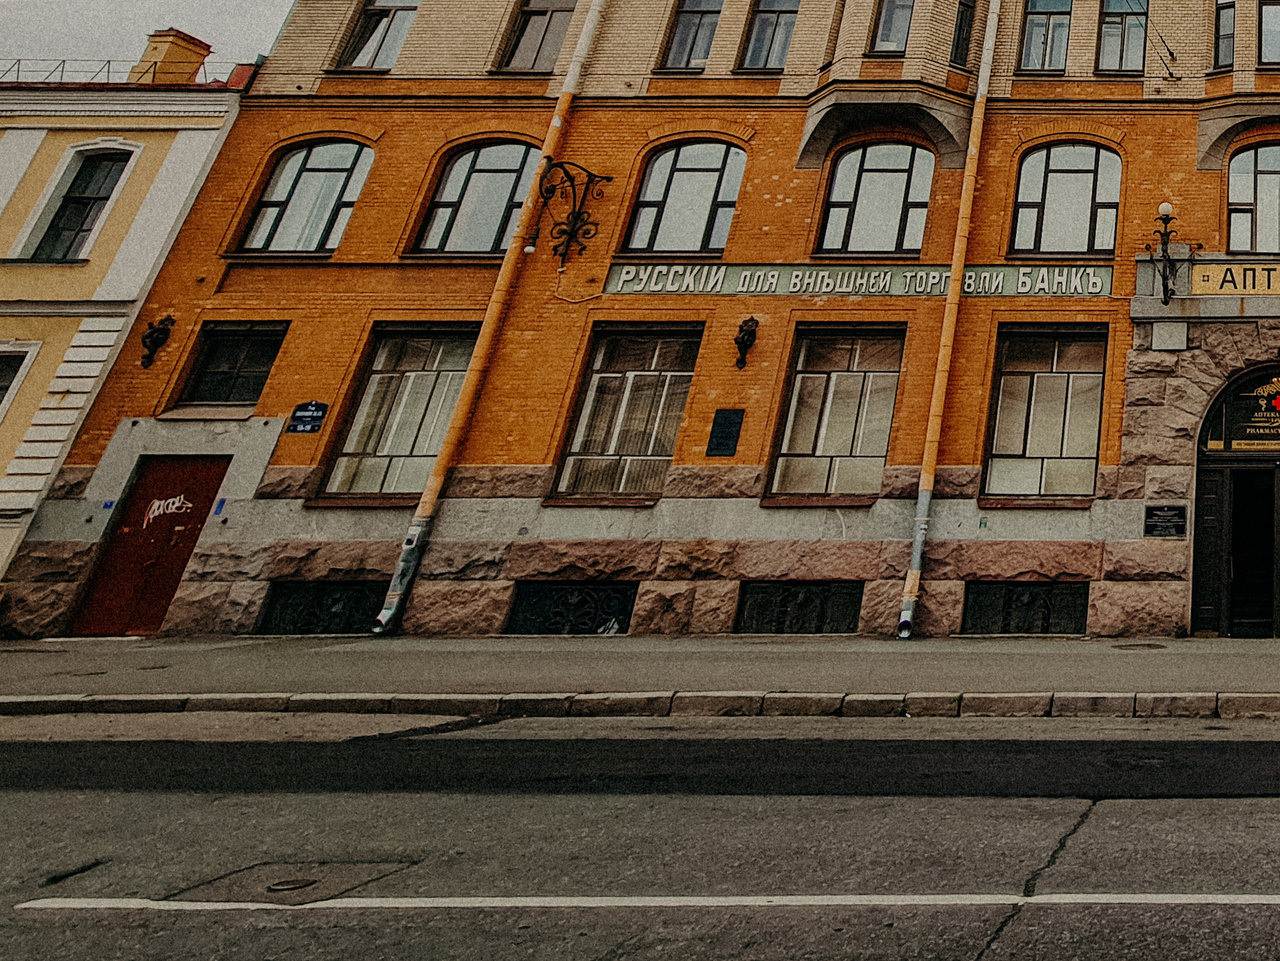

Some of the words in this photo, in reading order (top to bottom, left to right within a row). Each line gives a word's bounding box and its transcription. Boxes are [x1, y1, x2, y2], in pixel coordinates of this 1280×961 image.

[736, 270, 779, 293] ДЛЯ
[902, 270, 1005, 294] ТОРГВЛИ
[1017, 267, 1104, 295] БАНКЪ
